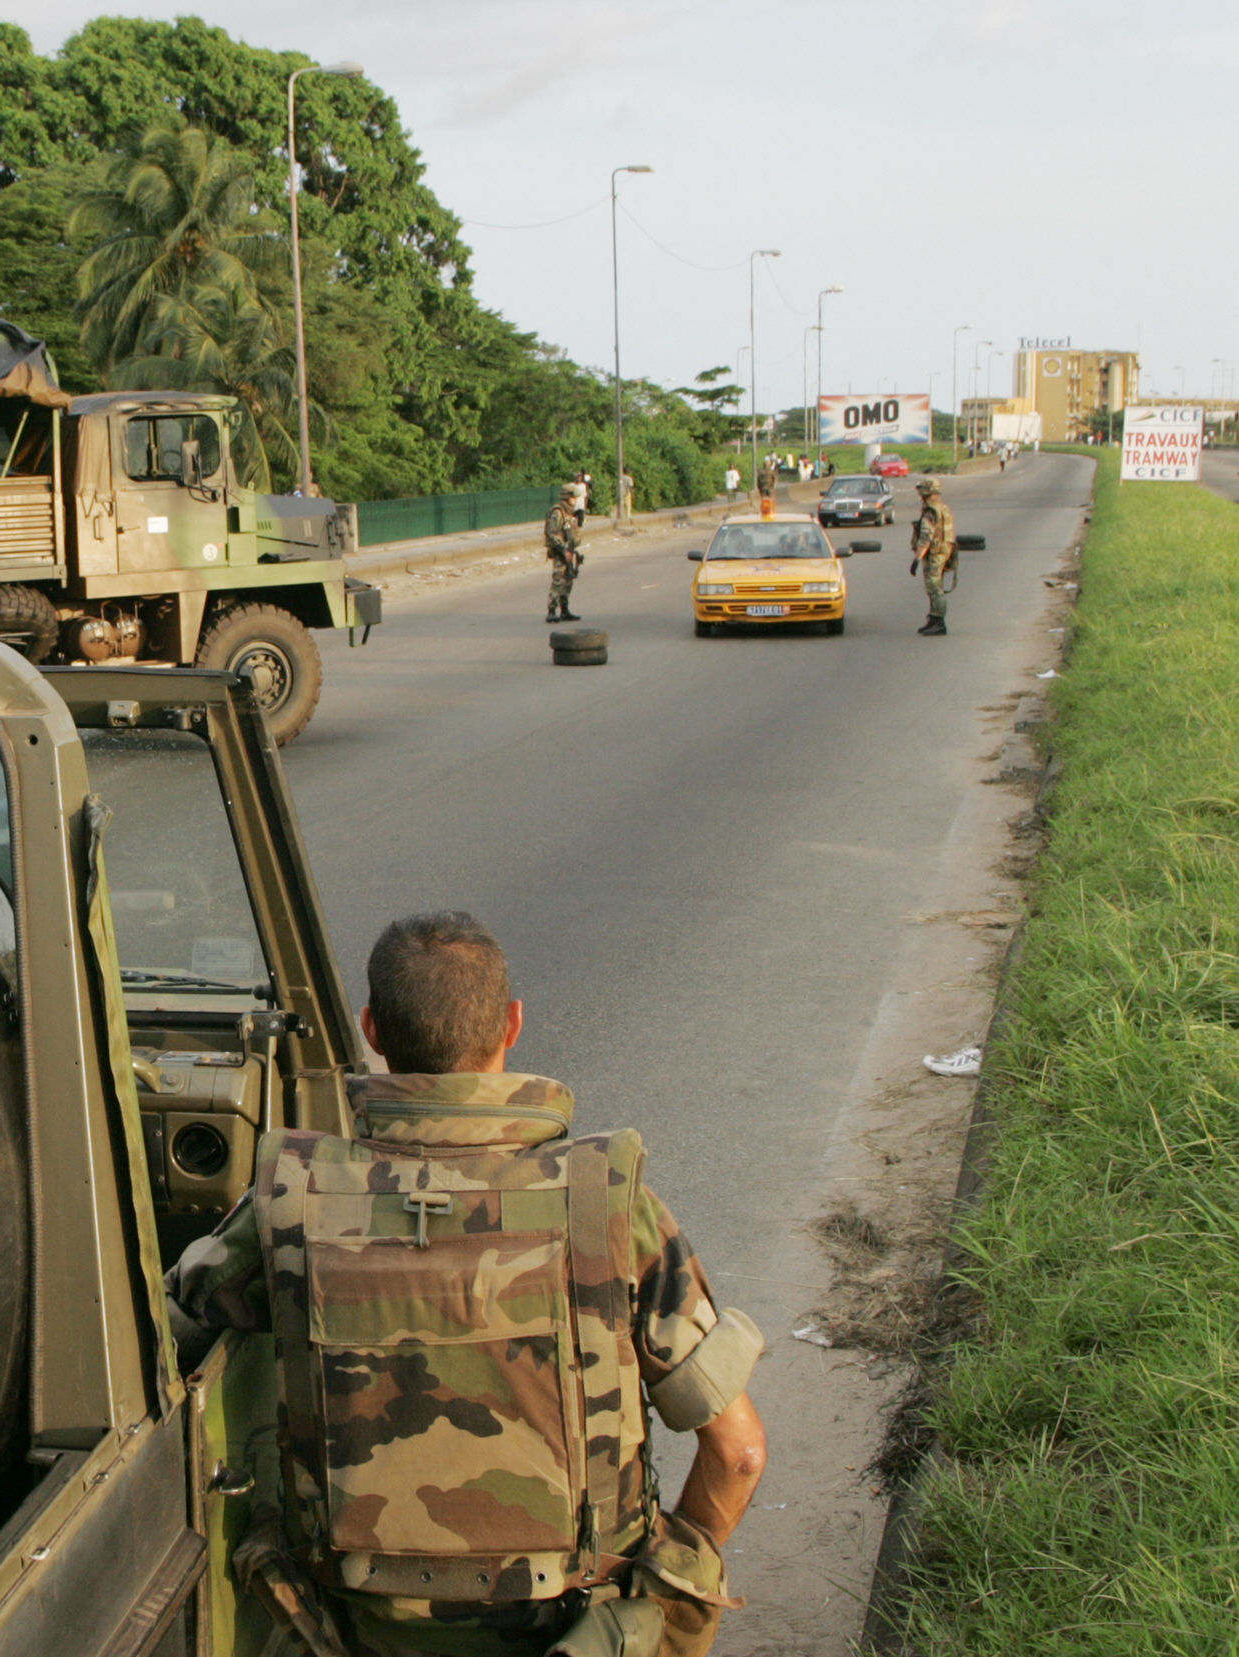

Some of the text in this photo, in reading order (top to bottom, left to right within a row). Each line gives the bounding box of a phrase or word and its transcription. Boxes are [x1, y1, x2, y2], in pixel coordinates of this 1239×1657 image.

[844, 399, 899, 429] OMO
[1160, 408, 1201, 422] CICF
[1125, 432, 1199, 448] TRAVAUX
[1124, 450, 1198, 466] TRAMWAY
[1135, 467, 1186, 478] CICF
